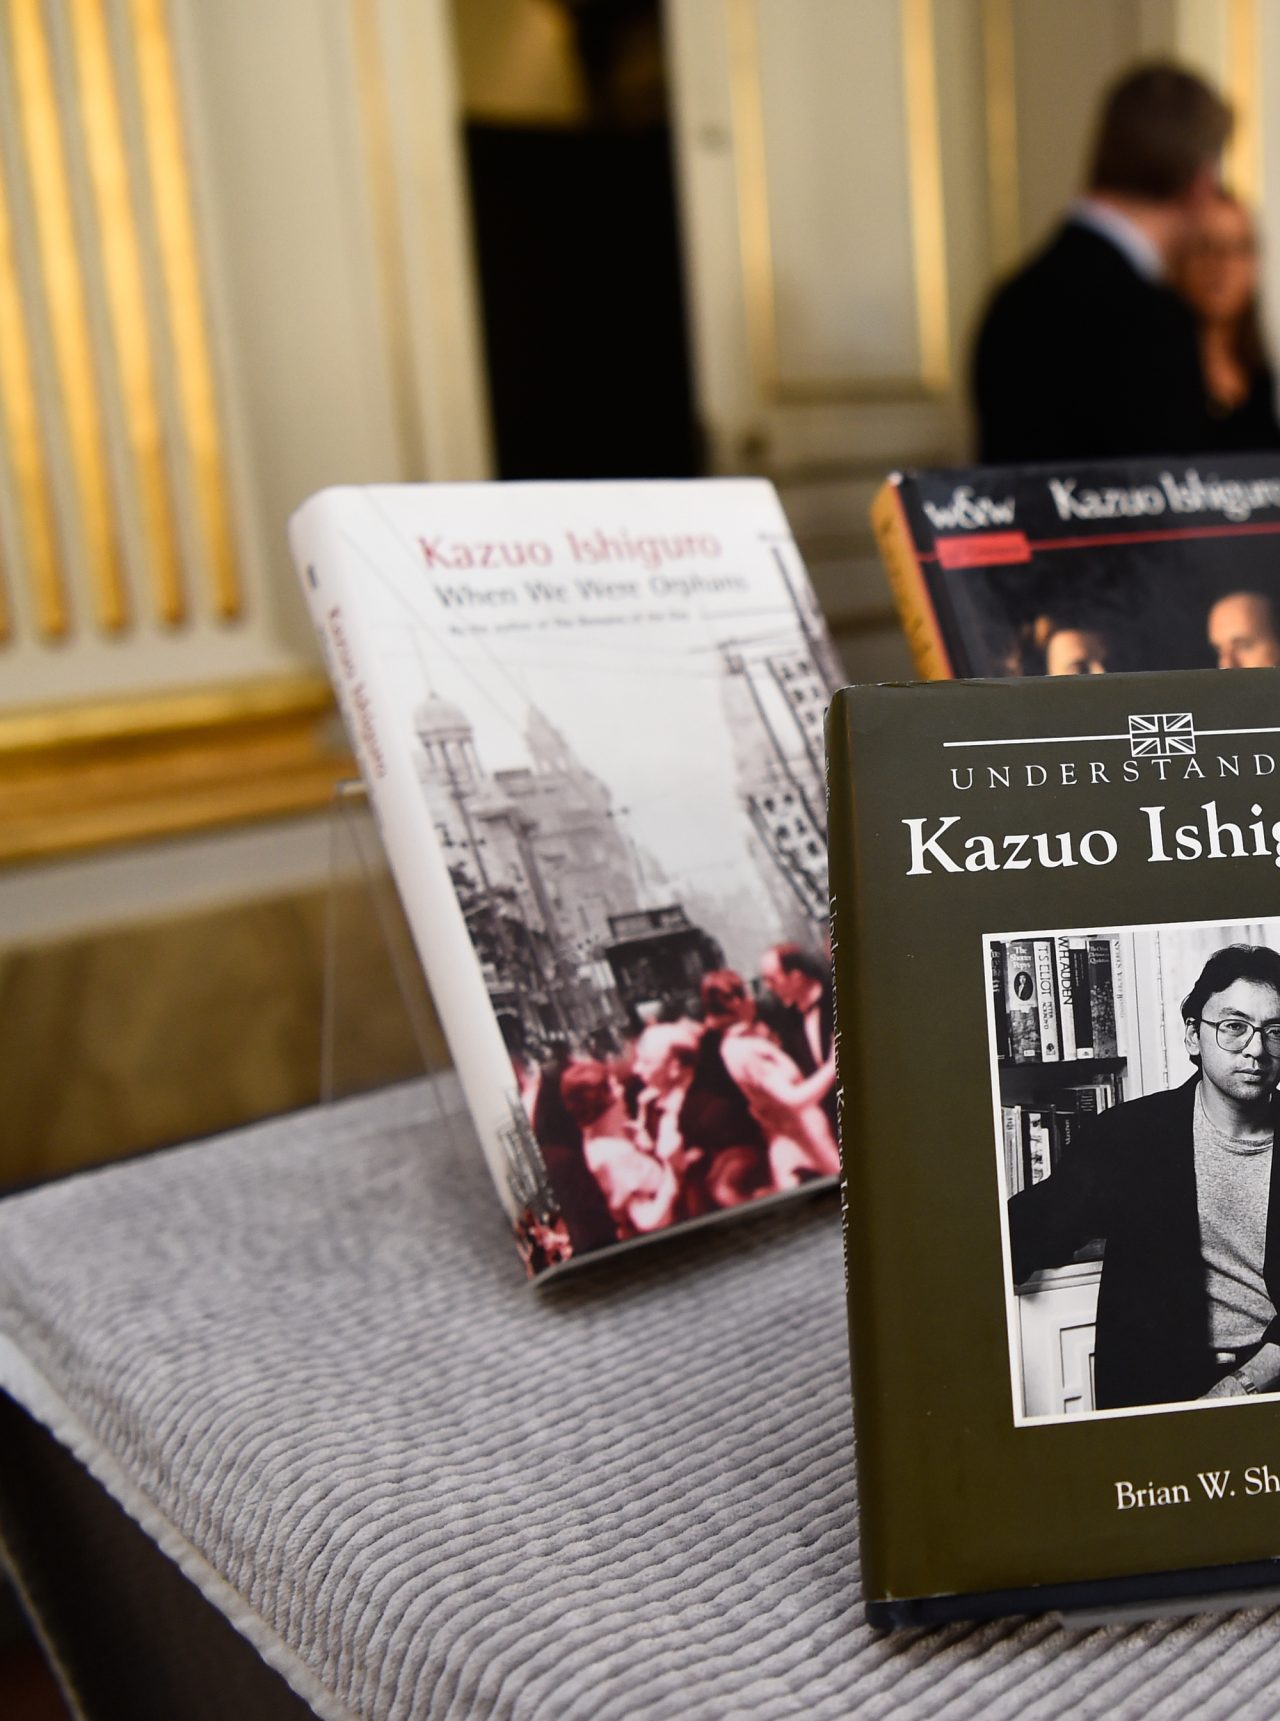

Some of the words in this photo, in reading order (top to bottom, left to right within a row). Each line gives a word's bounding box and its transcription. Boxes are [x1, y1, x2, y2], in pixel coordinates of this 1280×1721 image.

[1049, 478, 1165, 521] Kazuo
[418, 535, 553, 570] Kazuo
[565, 529, 722, 571] Ishiguro
[433, 582, 518, 609] When
[522, 579, 567, 604] We
[573, 577, 640, 602] Were
[648, 573, 748, 600] Orphans
[901, 815, 1118, 876] Kazuo
[1114, 1481, 1191, 1510] Brian
[1197, 1470, 1236, 1500] W.
